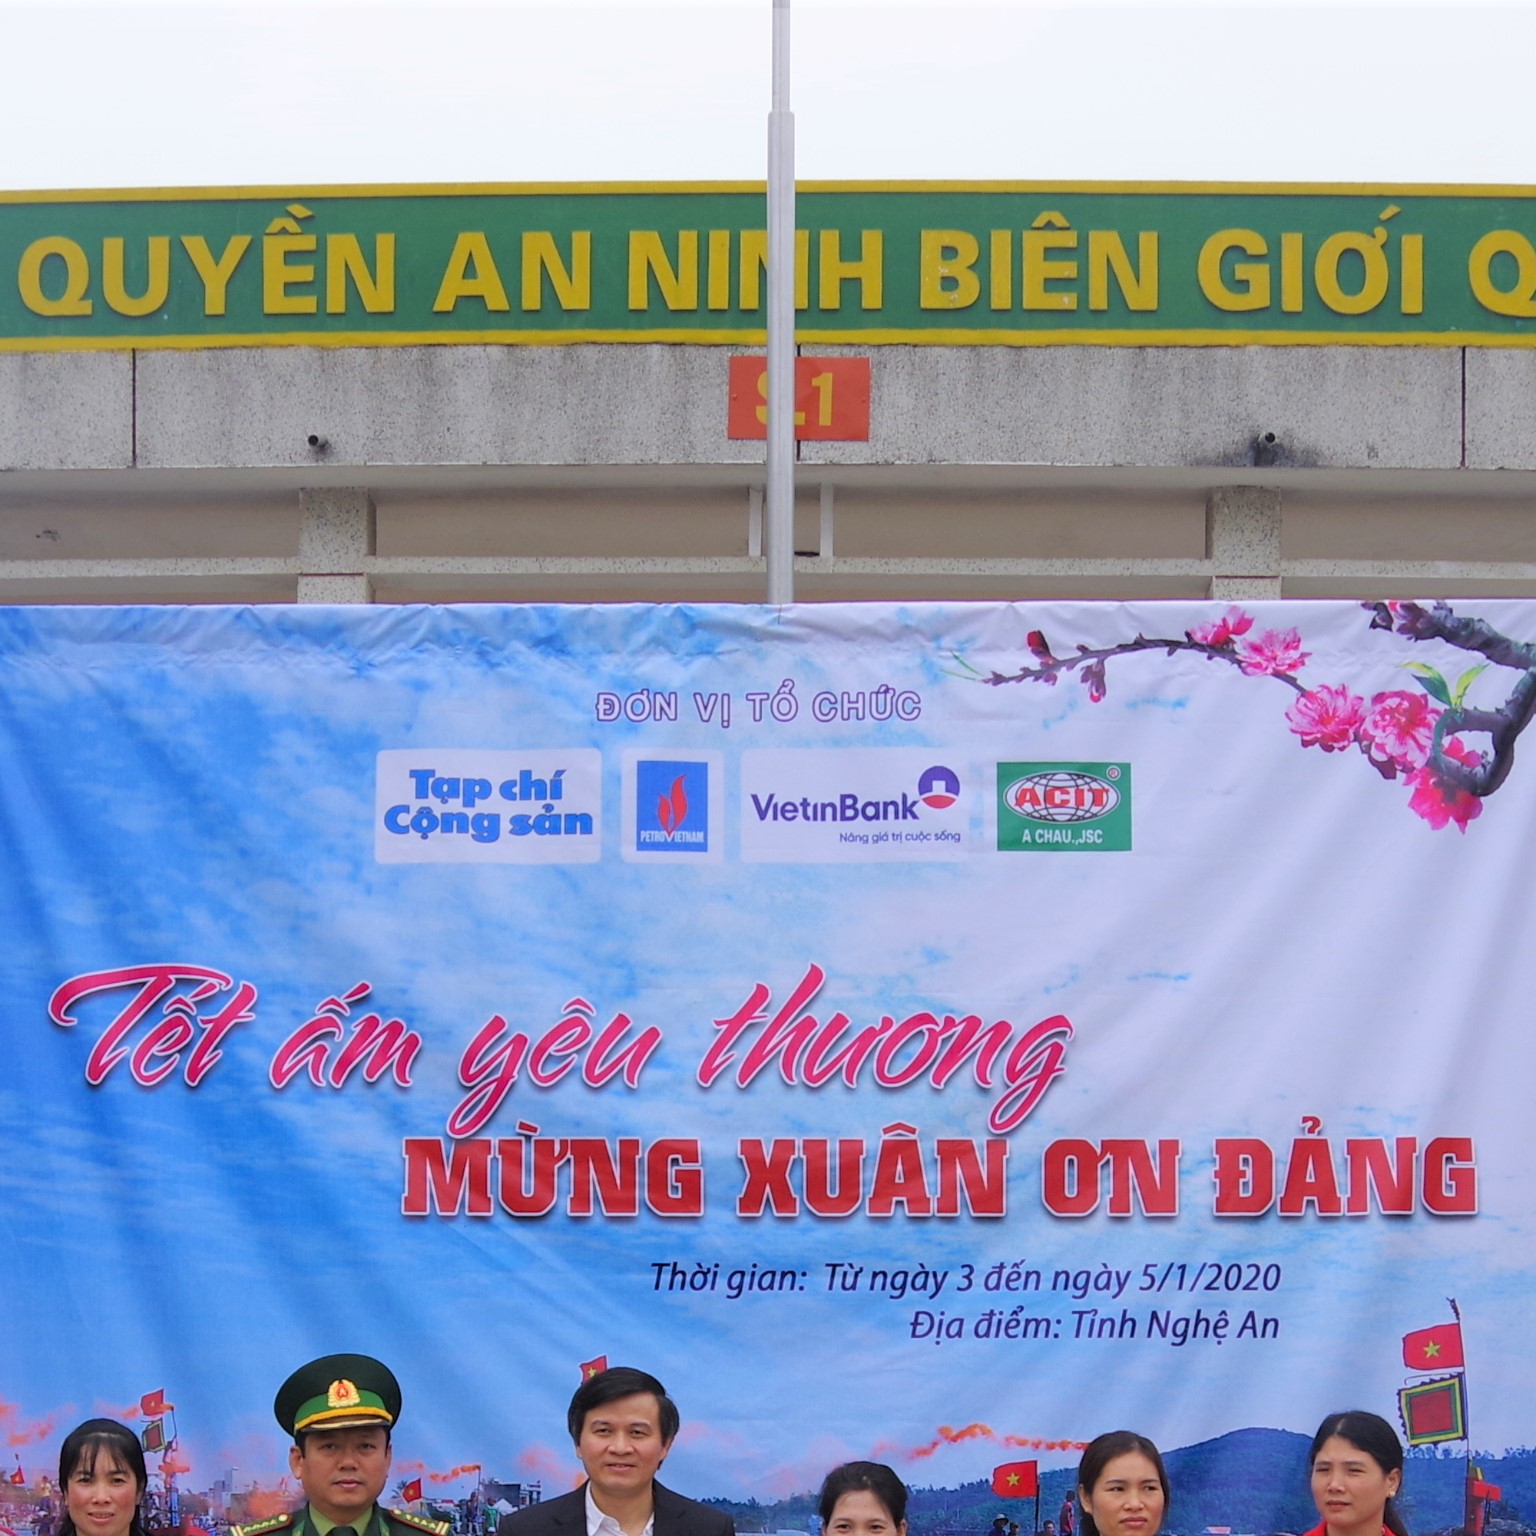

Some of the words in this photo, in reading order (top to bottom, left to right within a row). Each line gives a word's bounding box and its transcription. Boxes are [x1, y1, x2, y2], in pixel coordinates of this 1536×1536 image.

[17, 204, 395, 317] QUYỀN
[432, 229, 592, 312] AN
[920, 211, 1159, 311] BIÊN
[1198, 204, 1424, 315] GIỚI
[596, 689, 678, 723] ĐƠN
[693, 693, 731, 728] VỊ
[746, 679, 799, 723] TỔ
[812, 684, 922, 723] CHỨC
[409, 769, 492, 807] Tạp
[499, 769, 567, 801] chí
[750, 792, 921, 822] VietinBank
[1014, 787, 1110, 808] ACIT
[384, 804, 501, 842] Cộng
[508, 803, 593, 835] sản
[839, 831, 868, 844] Nâng
[871, 831, 889, 845] giá
[891, 832, 902, 844] trị
[905, 830, 932, 844] cuộc
[934, 828, 961, 844] sống
[48, 963, 258, 1089] Tết
[268, 981, 423, 1090] ấm
[445, 995, 662, 1139] yêu
[695, 963, 1074, 1135] thương
[401, 1120, 705, 1217] MỪNG
[737, 1121, 1013, 1218] XUÂN
[1041, 1137, 1182, 1218] ƠN
[1212, 1115, 1481, 1218] ĐẢNG
[651, 1262, 720, 1292] Thời
[726, 1264, 807, 1299] gian:
[824, 1260, 864, 1292] Từ
[869, 1264, 949, 1299] ngày
[957, 1265, 974, 1292] 3
[983, 1261, 1042, 1292] đến
[1051, 1264, 1132, 1299] ngày
[1138, 1263, 1283, 1295] 5/1/2020
[910, 1310, 966, 1346] Địa
[973, 1304, 1063, 1339] điểm:
[1071, 1309, 1138, 1339] Tỉnh
[1147, 1310, 1230, 1347] Nghệ
[1237, 1311, 1280, 1339] An
